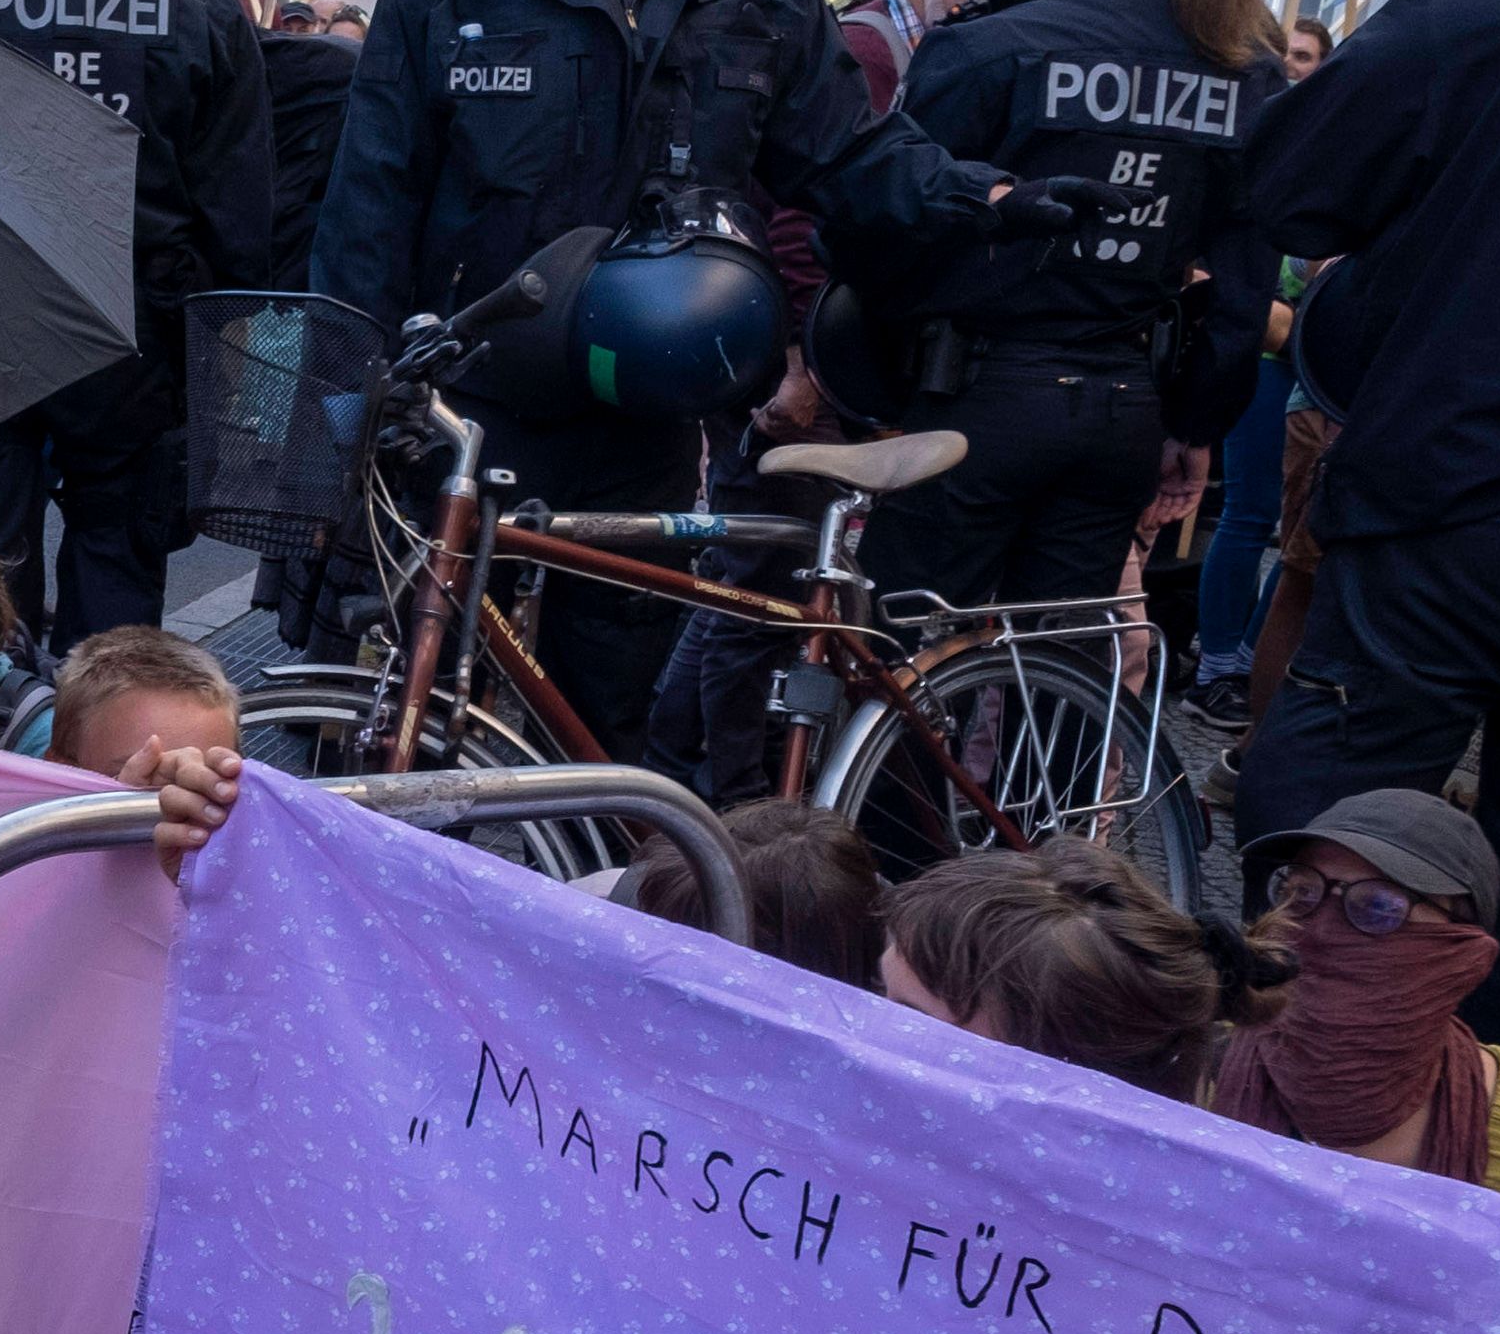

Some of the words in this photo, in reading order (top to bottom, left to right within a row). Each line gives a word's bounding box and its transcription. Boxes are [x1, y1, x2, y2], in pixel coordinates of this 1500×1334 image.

[53, 51, 102, 85] BE
[450, 67, 532, 92] POLIZEI
[1046, 62, 1240, 137] POLIZEI
[1109, 150, 1162, 187] BE
[481, 592, 546, 680] ERCULES
[897, 1222, 1053, 1334] FÜR
